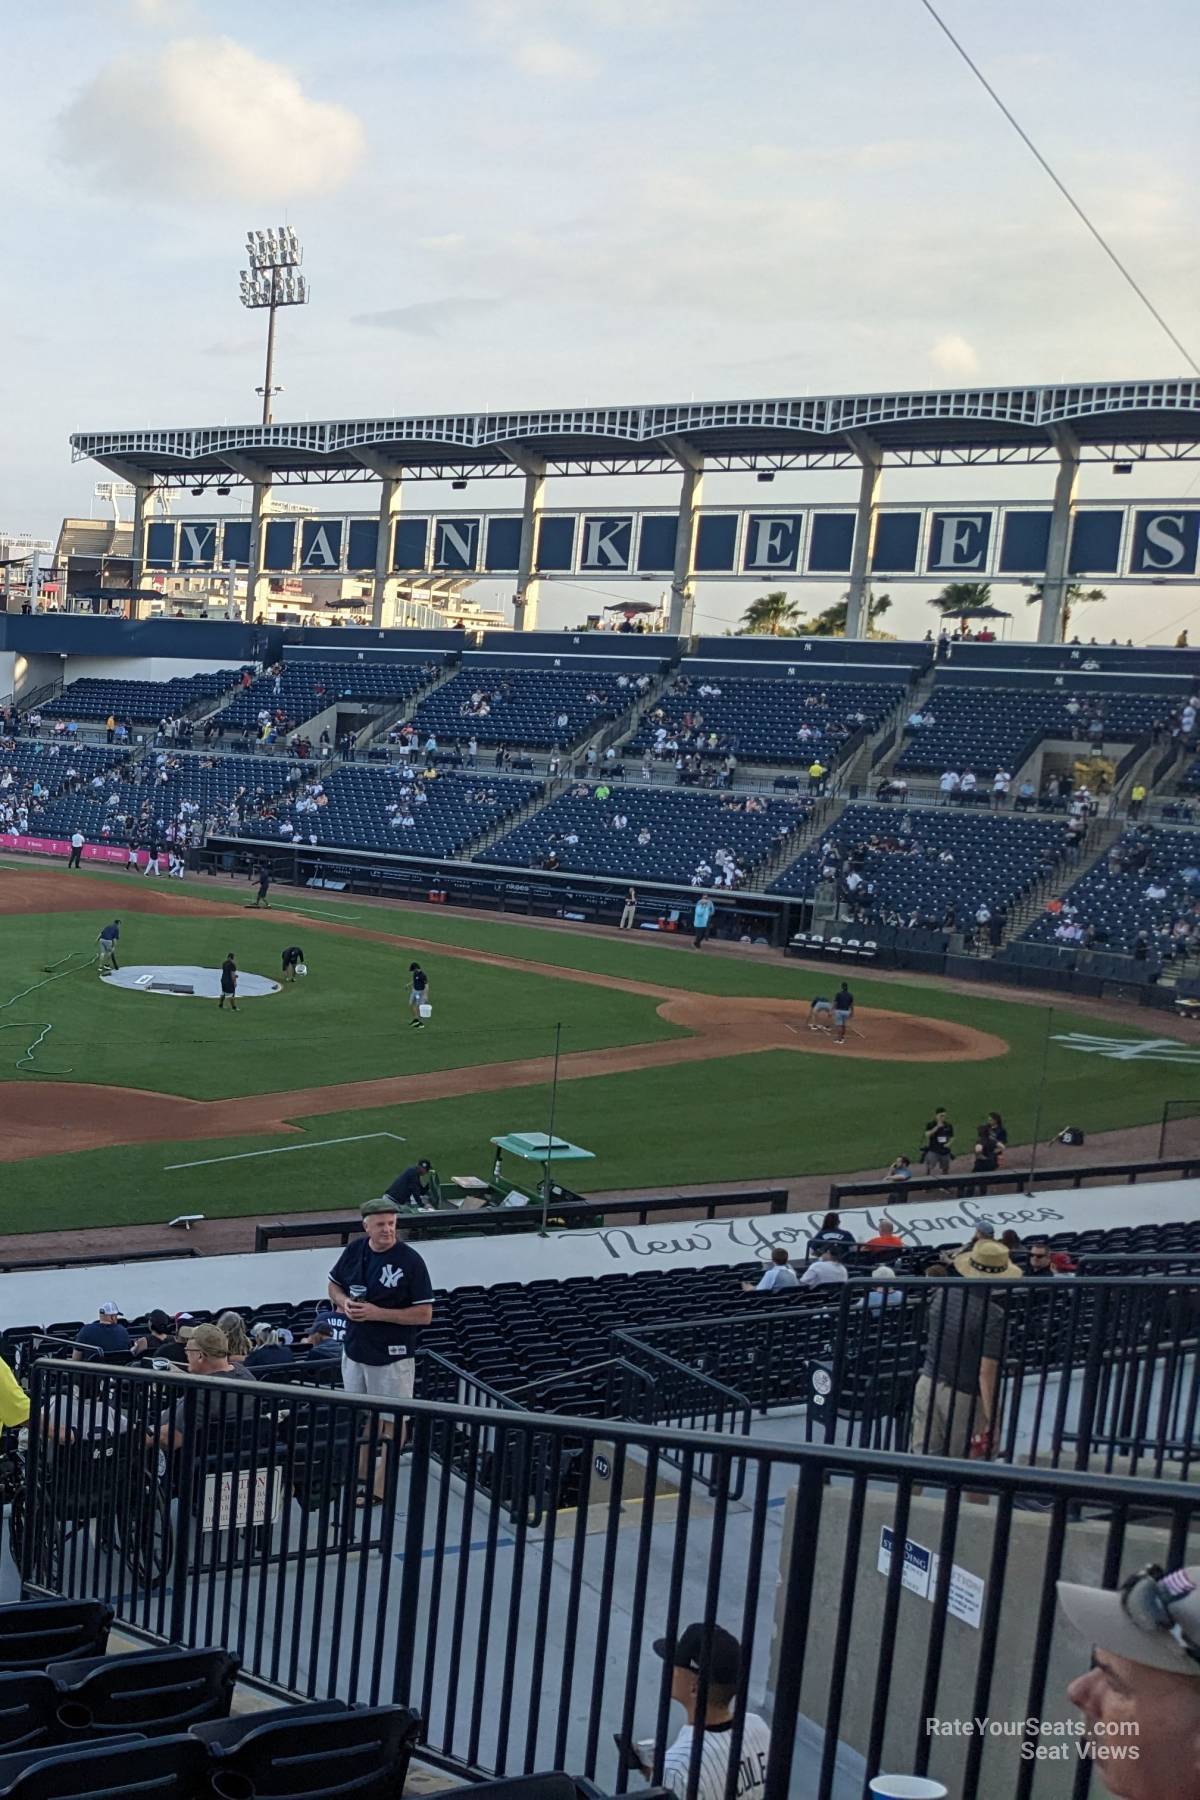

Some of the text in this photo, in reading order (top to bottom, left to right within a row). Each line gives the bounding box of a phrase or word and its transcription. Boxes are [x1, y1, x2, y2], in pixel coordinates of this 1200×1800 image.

[559, 1230, 712, 1259] New
[378, 1263, 404, 1288] NY
[595, 1459, 608, 1473] 117
[883, 1539, 927, 1569] STDING
